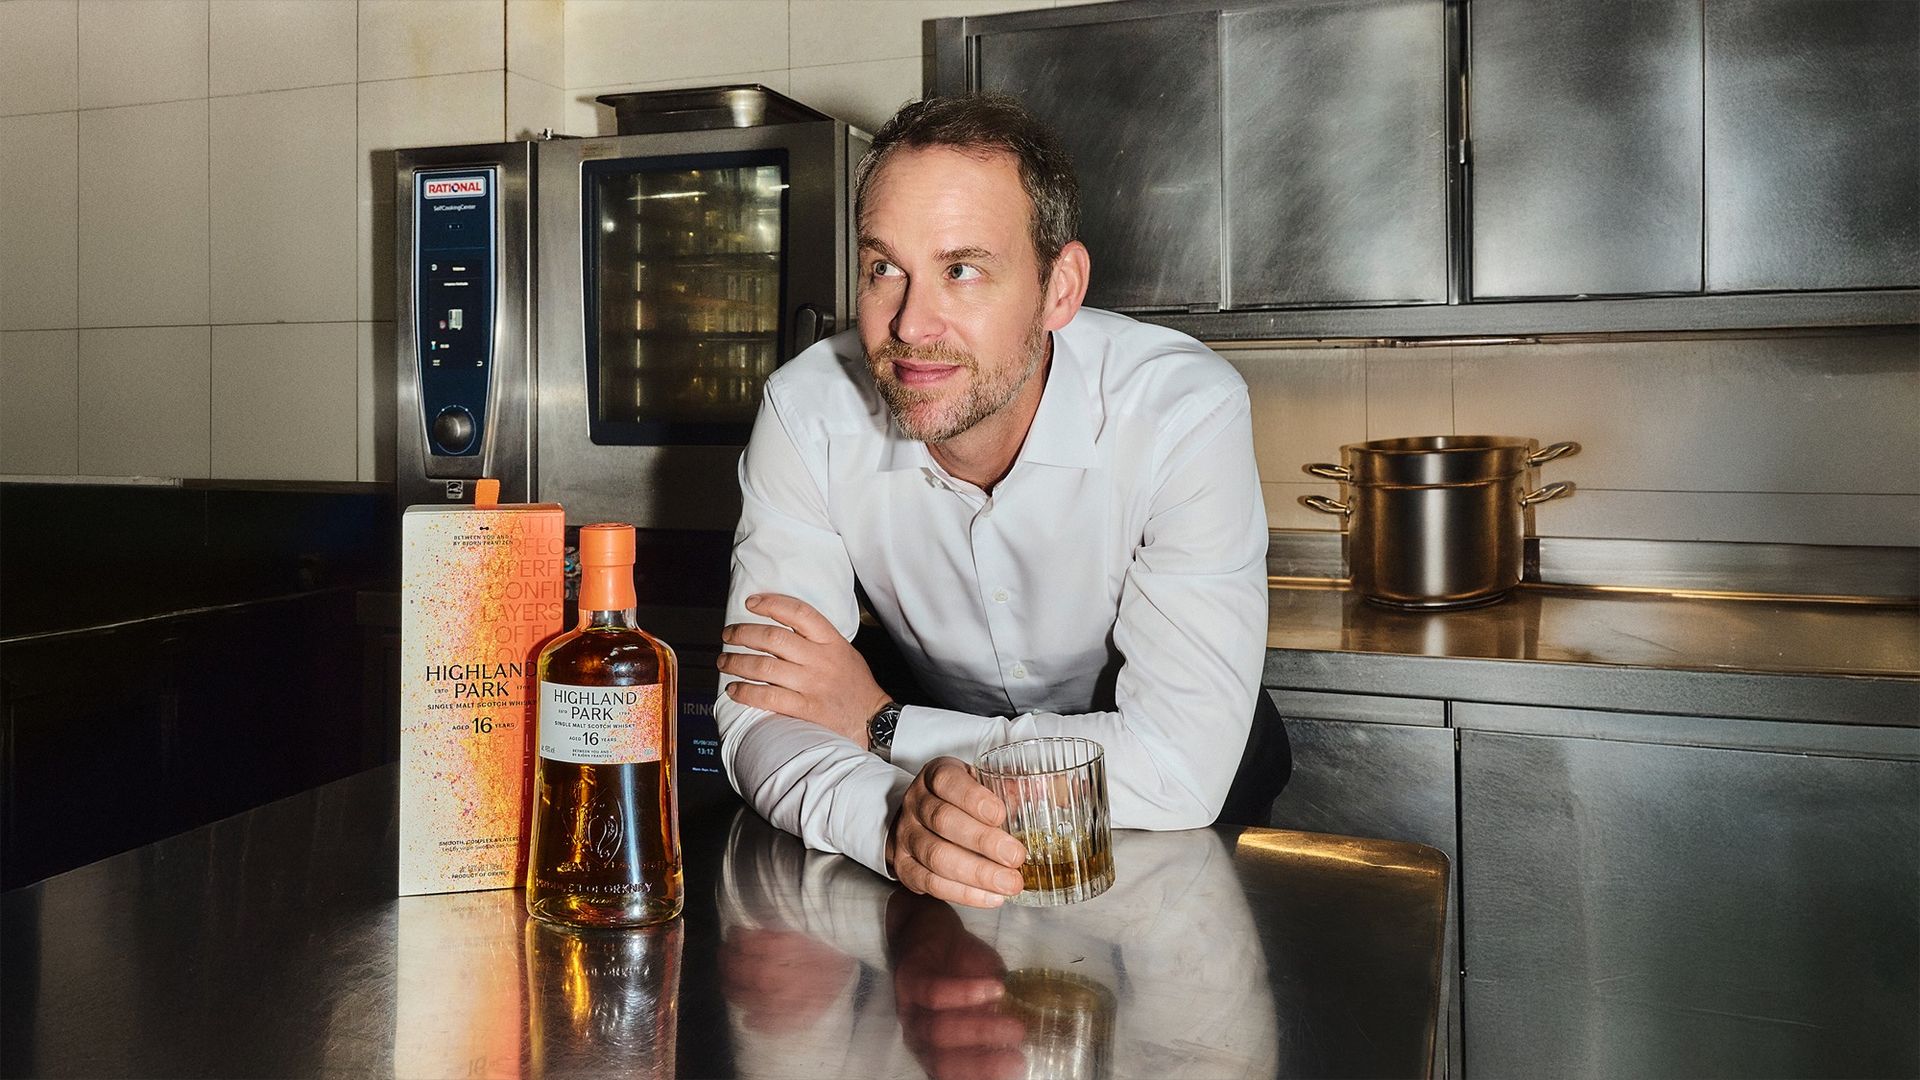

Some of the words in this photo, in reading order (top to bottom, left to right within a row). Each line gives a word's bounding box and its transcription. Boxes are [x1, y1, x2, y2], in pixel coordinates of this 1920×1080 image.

[428, 182, 482, 193] RATIONAL
[483, 602, 562, 622] LAYERS
[426, 662, 538, 681] HIGHLAND
[454, 681, 510, 698] PARK
[554, 689, 638, 706] HIGHLAND
[571, 707, 614, 721] PARK
[471, 716, 493, 734] 16
[554, 720, 571, 728] SINGLE
[582, 731, 600, 746] 16
